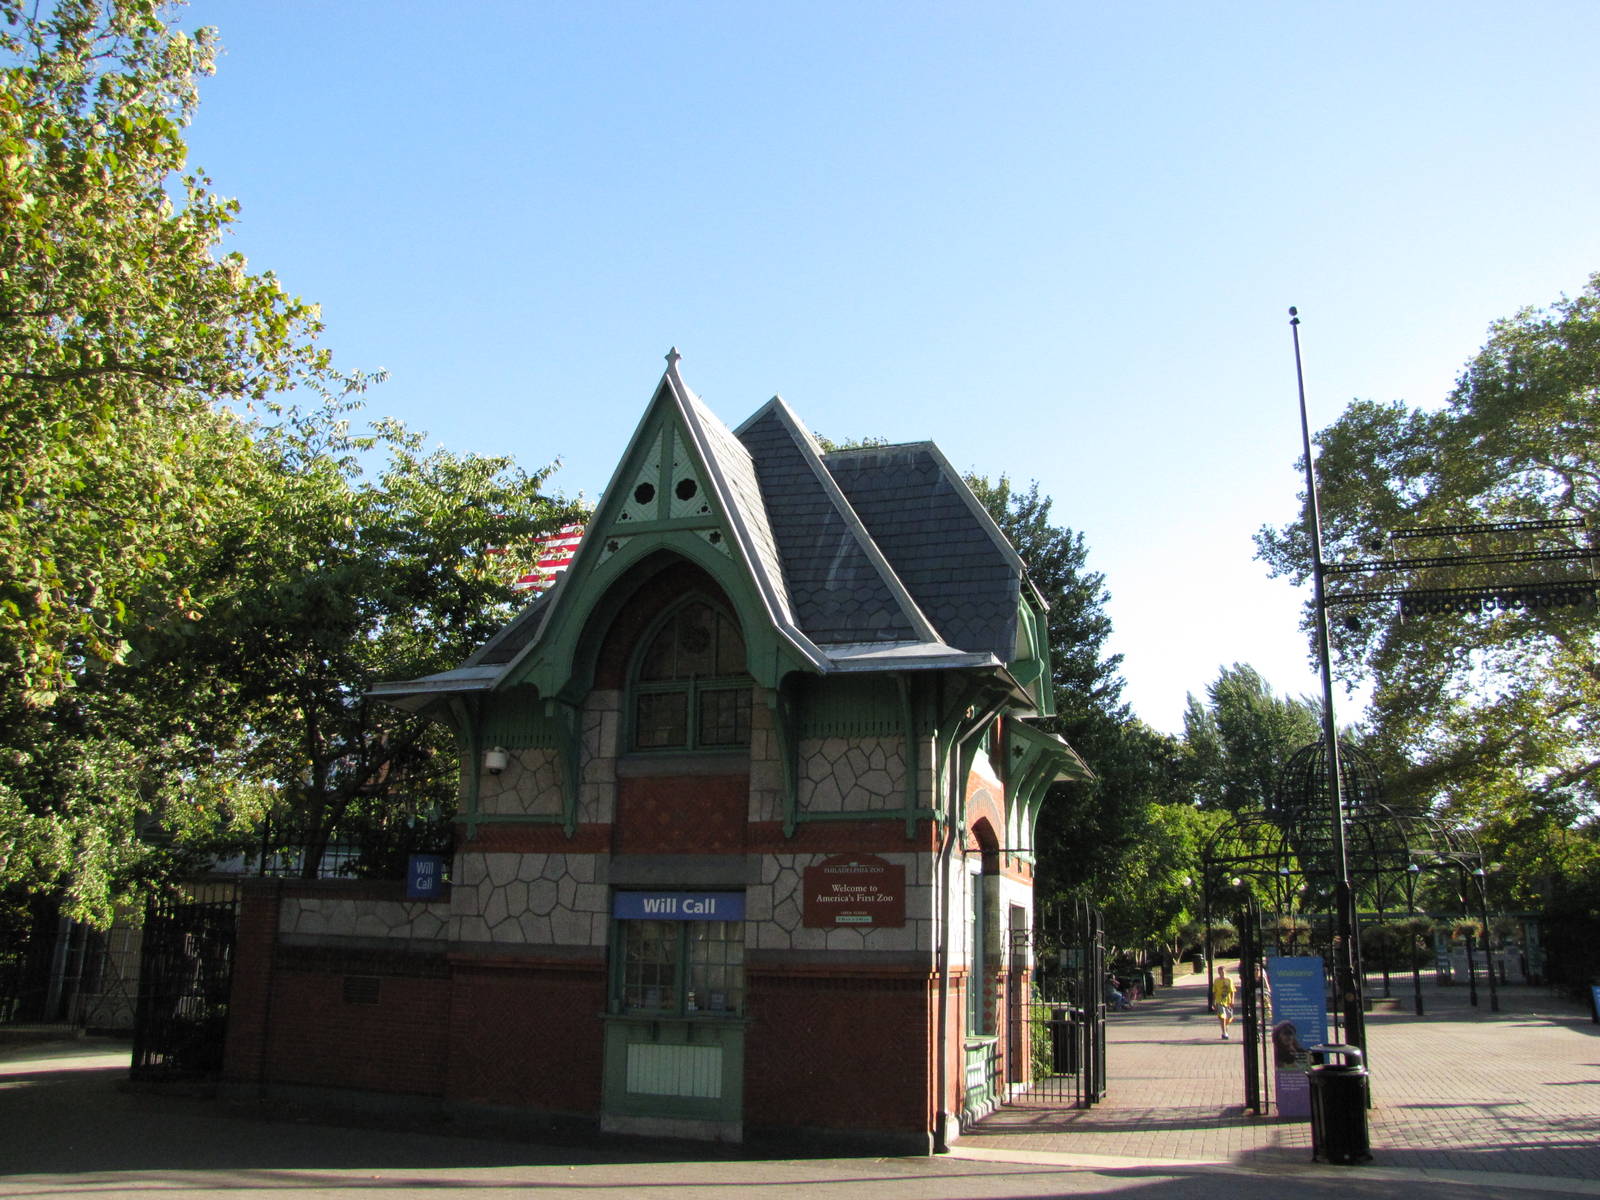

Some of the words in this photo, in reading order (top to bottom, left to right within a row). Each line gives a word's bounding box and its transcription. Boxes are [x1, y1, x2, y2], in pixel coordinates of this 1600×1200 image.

[416, 861, 434, 875] Will
[416, 877, 432, 890] Call
[831, 884, 867, 892] Welcome
[816, 893, 855, 902] America's
[857, 893, 875, 902] First
[876, 893, 894, 902] Zoo
[643, 898, 677, 913] Will
[682, 898, 716, 914] Call
